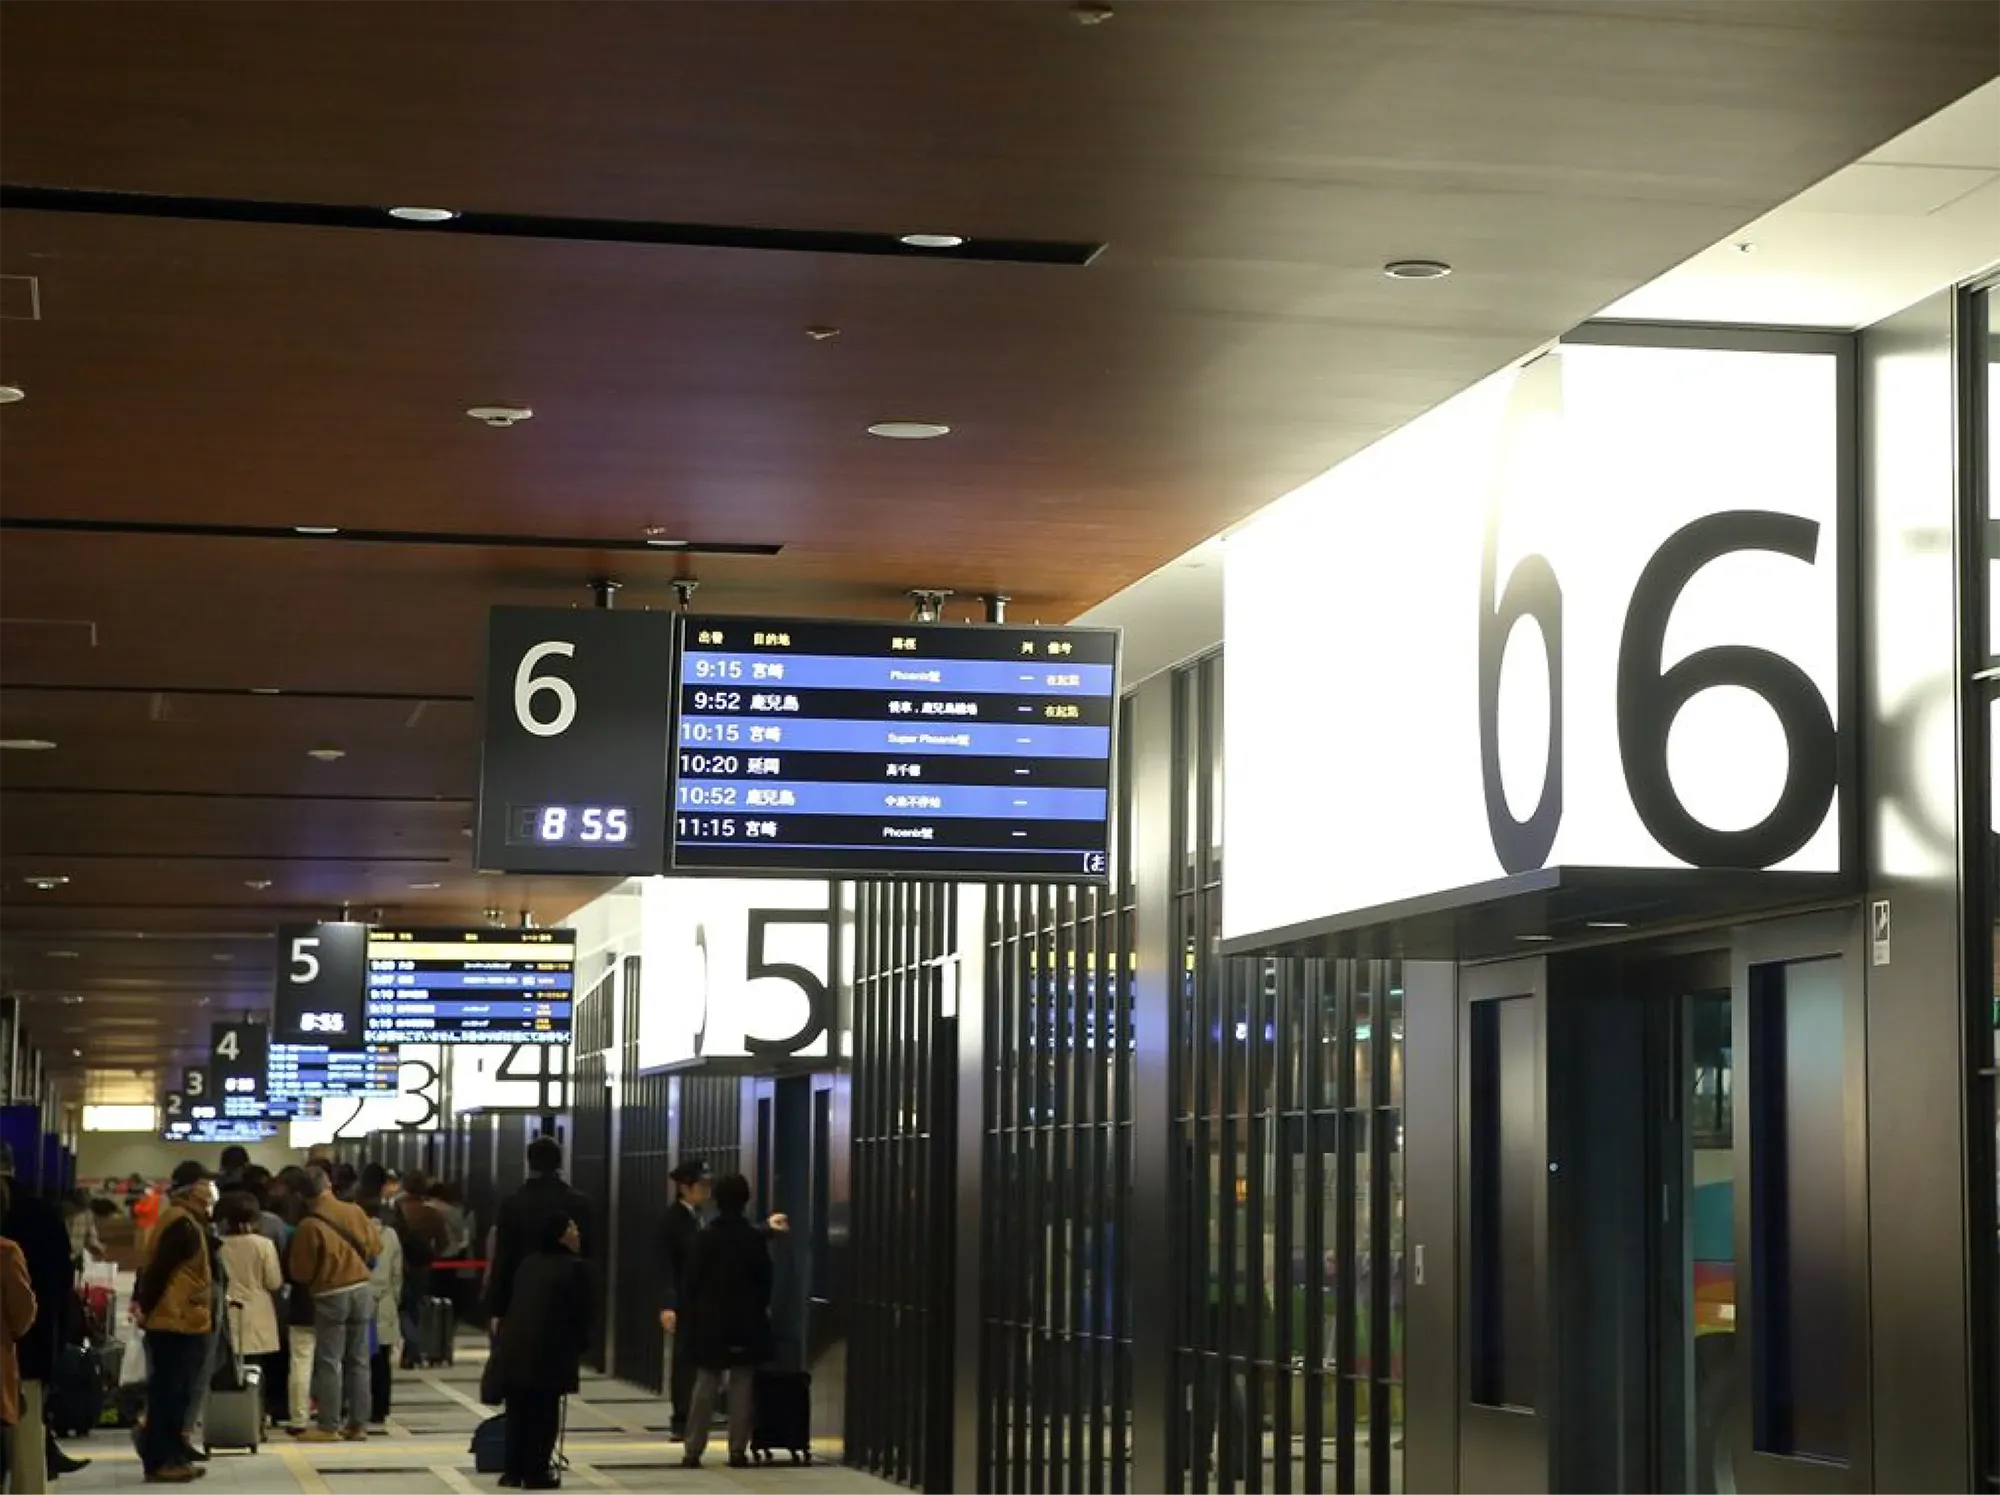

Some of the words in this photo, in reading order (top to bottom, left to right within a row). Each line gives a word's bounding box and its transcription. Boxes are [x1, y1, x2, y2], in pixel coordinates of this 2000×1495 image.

[696, 661, 742, 678] 9:15
[515, 641, 577, 737] 6
[1617, 508, 1840, 869] 6
[694, 692, 741, 710] 9:52
[682, 724, 739, 741] 10:15
[681, 755, 738, 773] 10:20
[679, 787, 737, 805] 10:52
[678, 818, 736, 837] 11:15
[290, 938, 320, 983] 5
[744, 908, 831, 1057] 5
[217, 1031, 240, 1060] 4
[187, 1071, 204, 1095] 3
[168, 1095, 182, 1114] 2
[394, 1060, 439, 1131] 3
